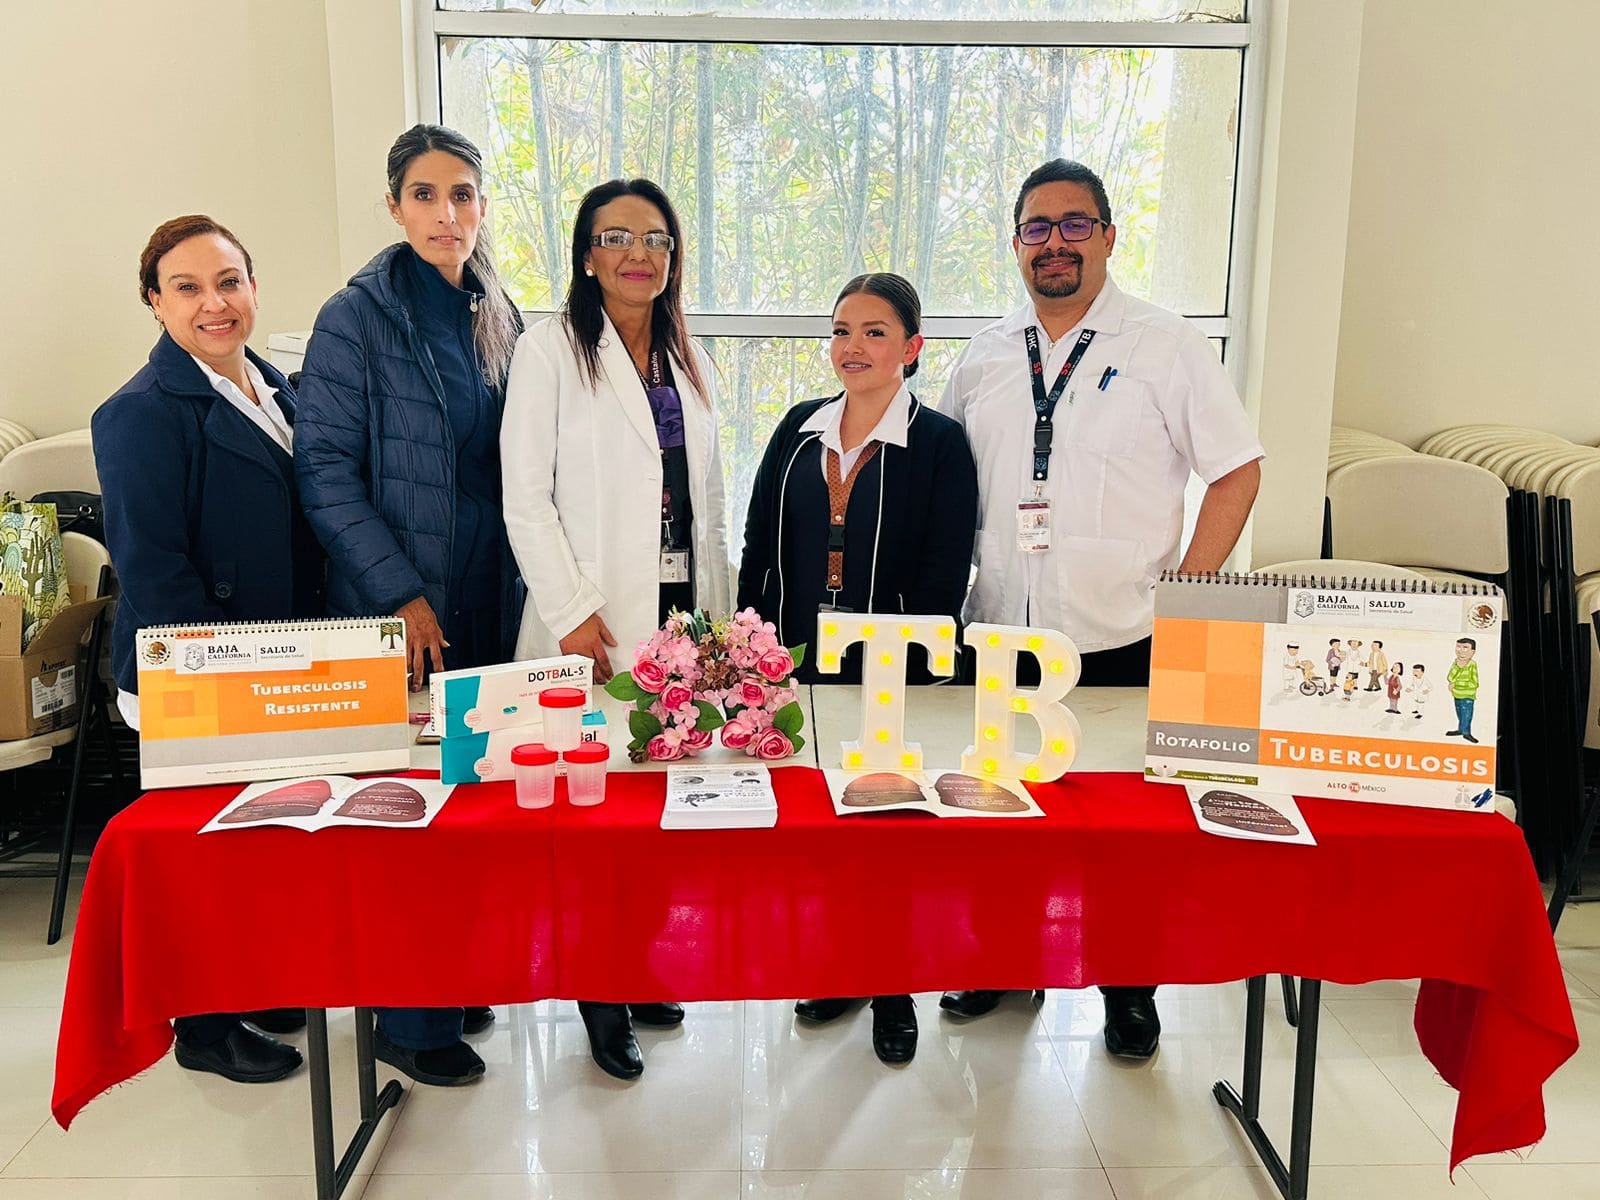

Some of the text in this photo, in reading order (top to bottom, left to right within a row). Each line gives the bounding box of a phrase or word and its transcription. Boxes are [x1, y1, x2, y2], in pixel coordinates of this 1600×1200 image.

[1317, 595, 1348, 604] BAJA
[1369, 600, 1406, 609] SALUD
[208, 645, 239, 654] BAJA
[260, 645, 297, 655] SALUD
[208, 652, 251, 660] CALIFORNIA
[250, 679, 368, 696] TUBERCULOSIS
[817, 613, 1082, 783] TB
[265, 700, 361, 716] RESISTENTE
[1155, 731, 1251, 753] ROTAFOLIO
[1269, 737, 1489, 777] TUBERCULOSIS
[1327, 782, 1347, 790] ALTO
